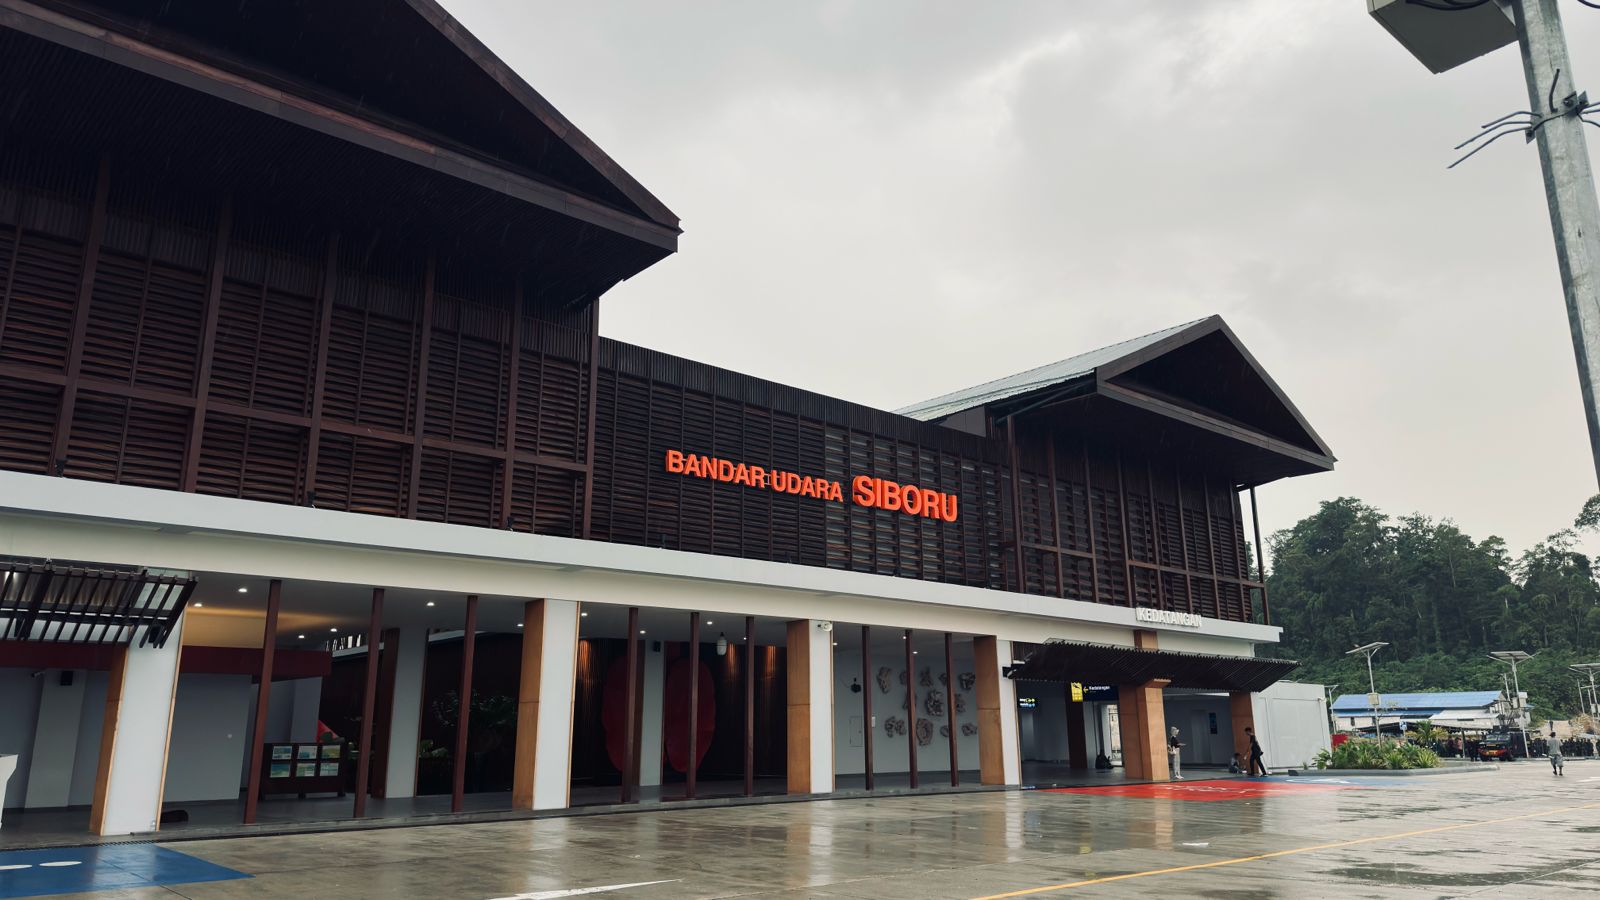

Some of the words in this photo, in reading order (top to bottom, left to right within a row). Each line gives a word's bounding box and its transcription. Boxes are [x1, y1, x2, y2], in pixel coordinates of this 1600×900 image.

[666, 449, 765, 488] BANDAR
[771, 470, 843, 502] UDARA
[852, 475, 958, 522] SIBORU
[1136, 607, 1202, 627] KEDATANGAN
